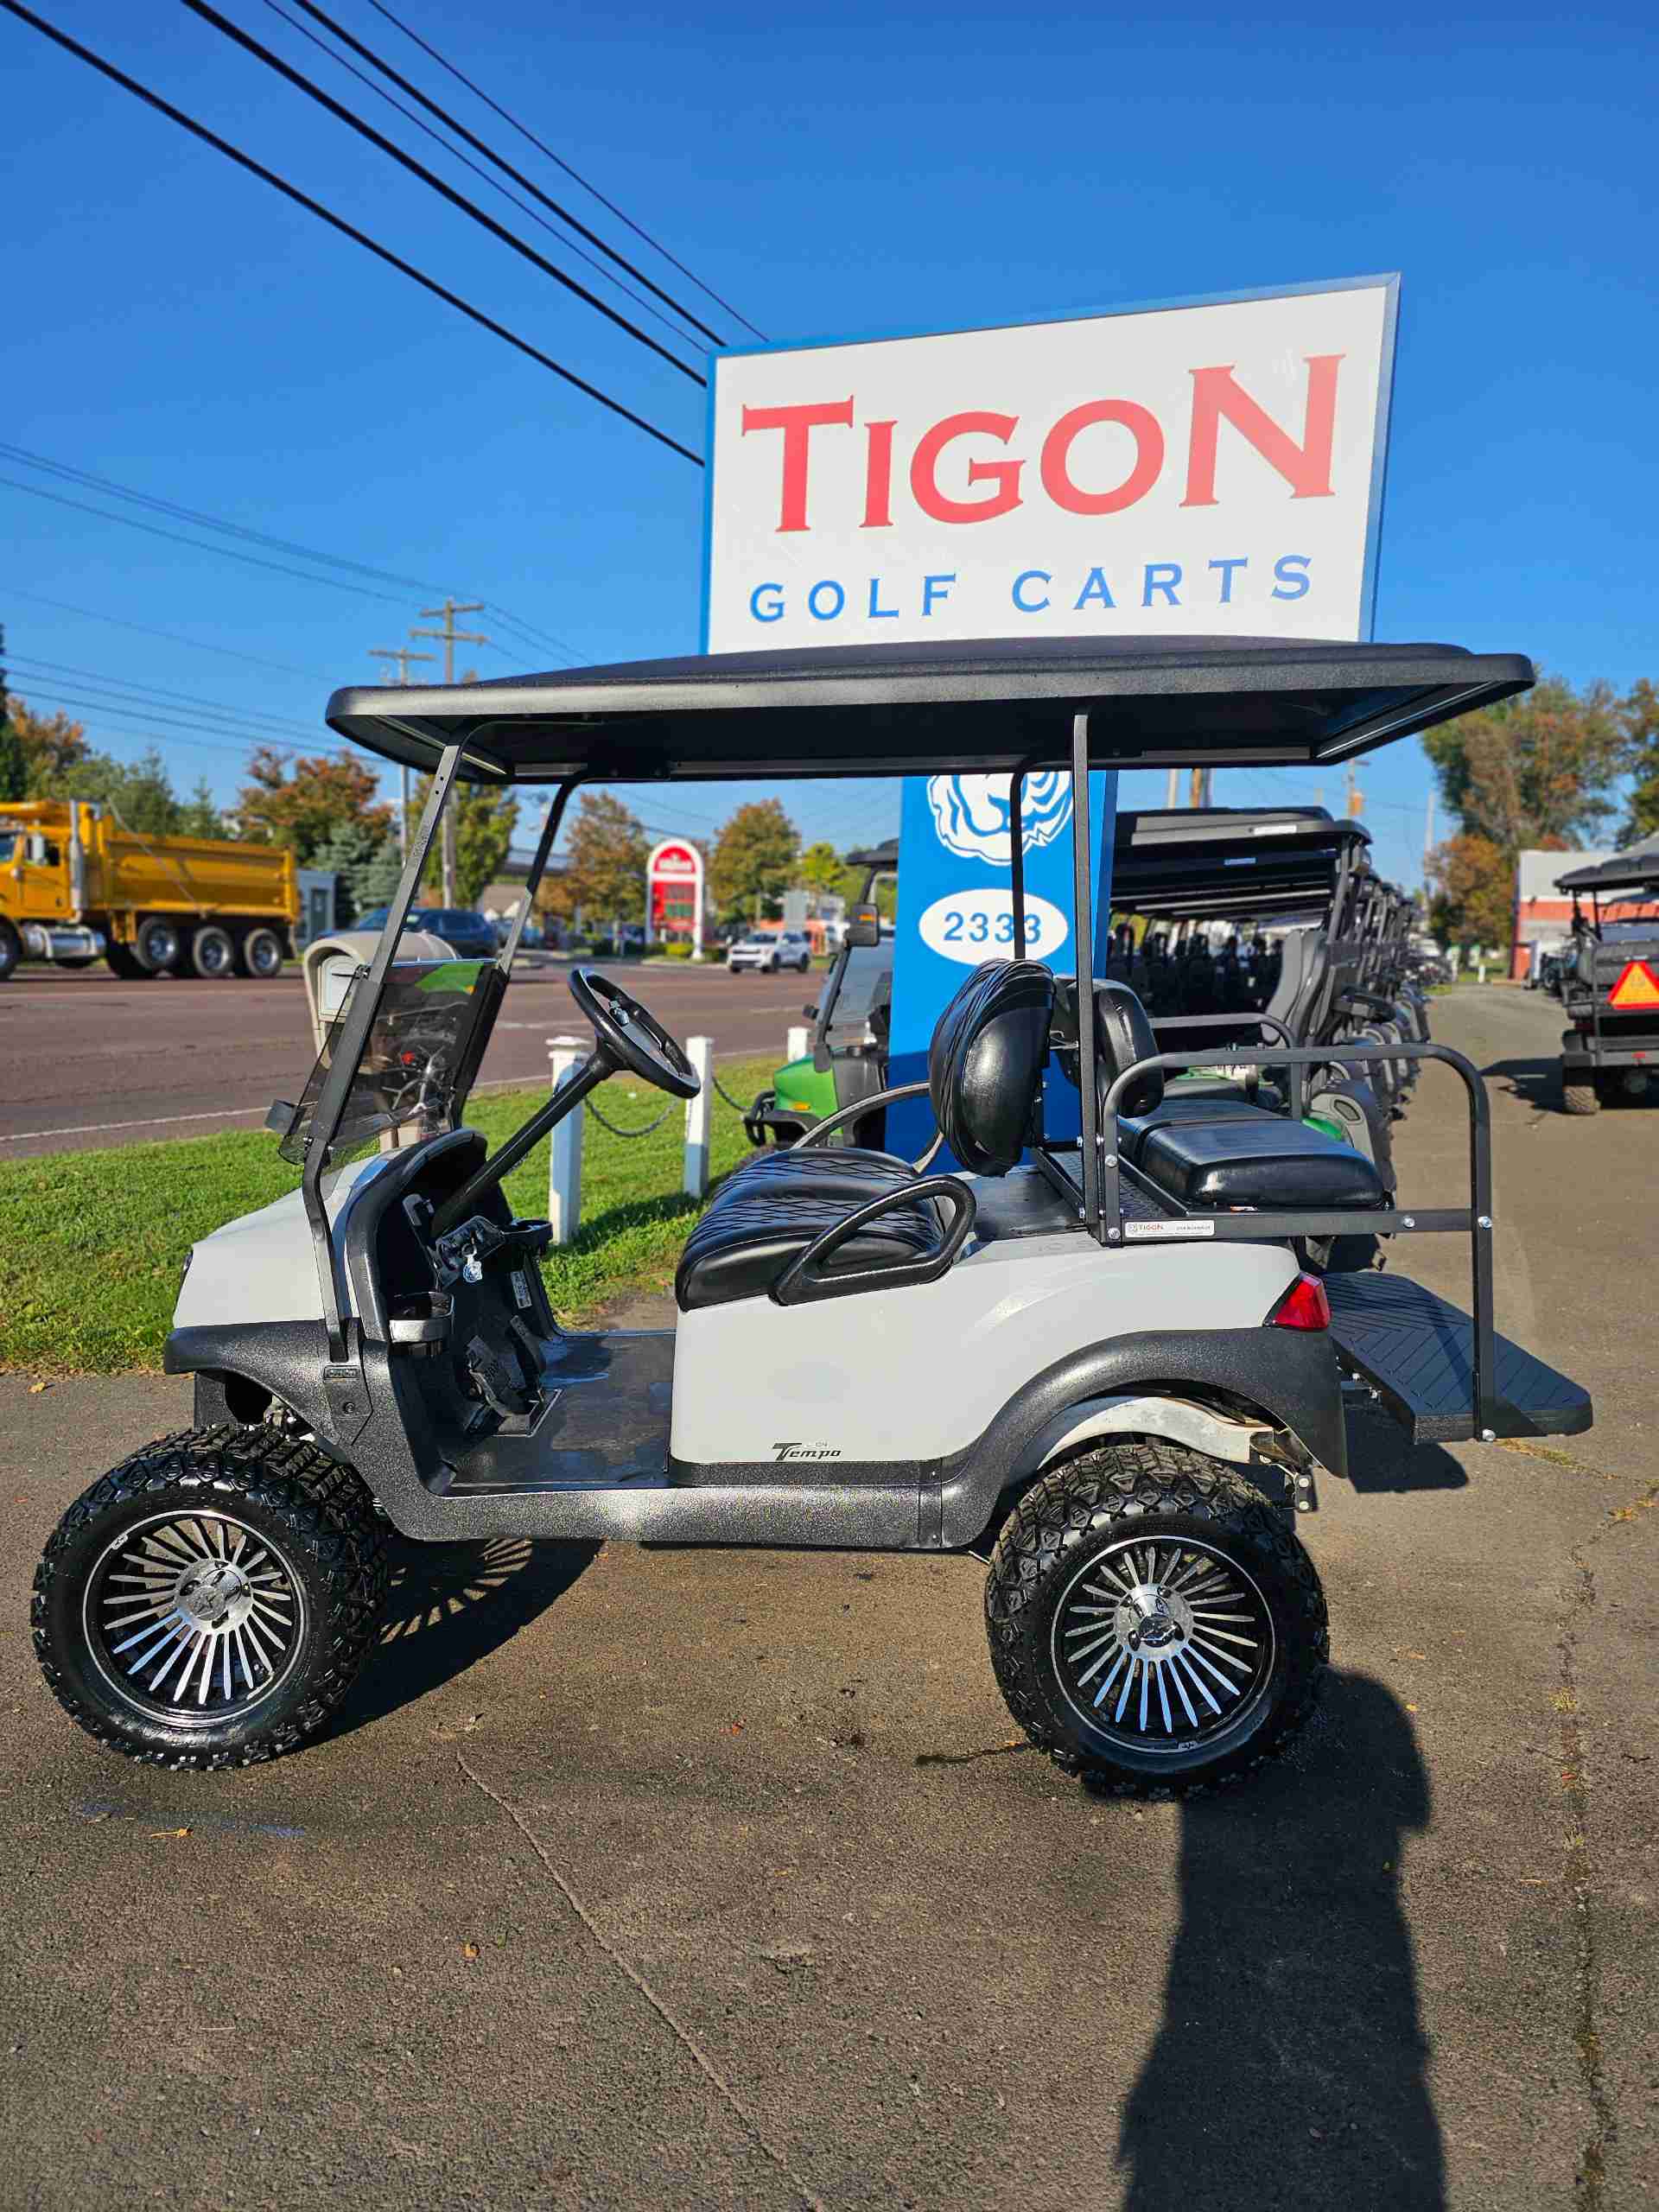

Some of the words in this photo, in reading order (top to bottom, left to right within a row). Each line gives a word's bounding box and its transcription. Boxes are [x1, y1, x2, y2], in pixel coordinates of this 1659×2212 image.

[741, 353, 1346, 532] TIGON
[749, 573, 957, 623] GOLF
[1011, 554, 1313, 614] CARTS
[943, 912, 1042, 945] 2333
[772, 1442, 842, 1461] Tempo
